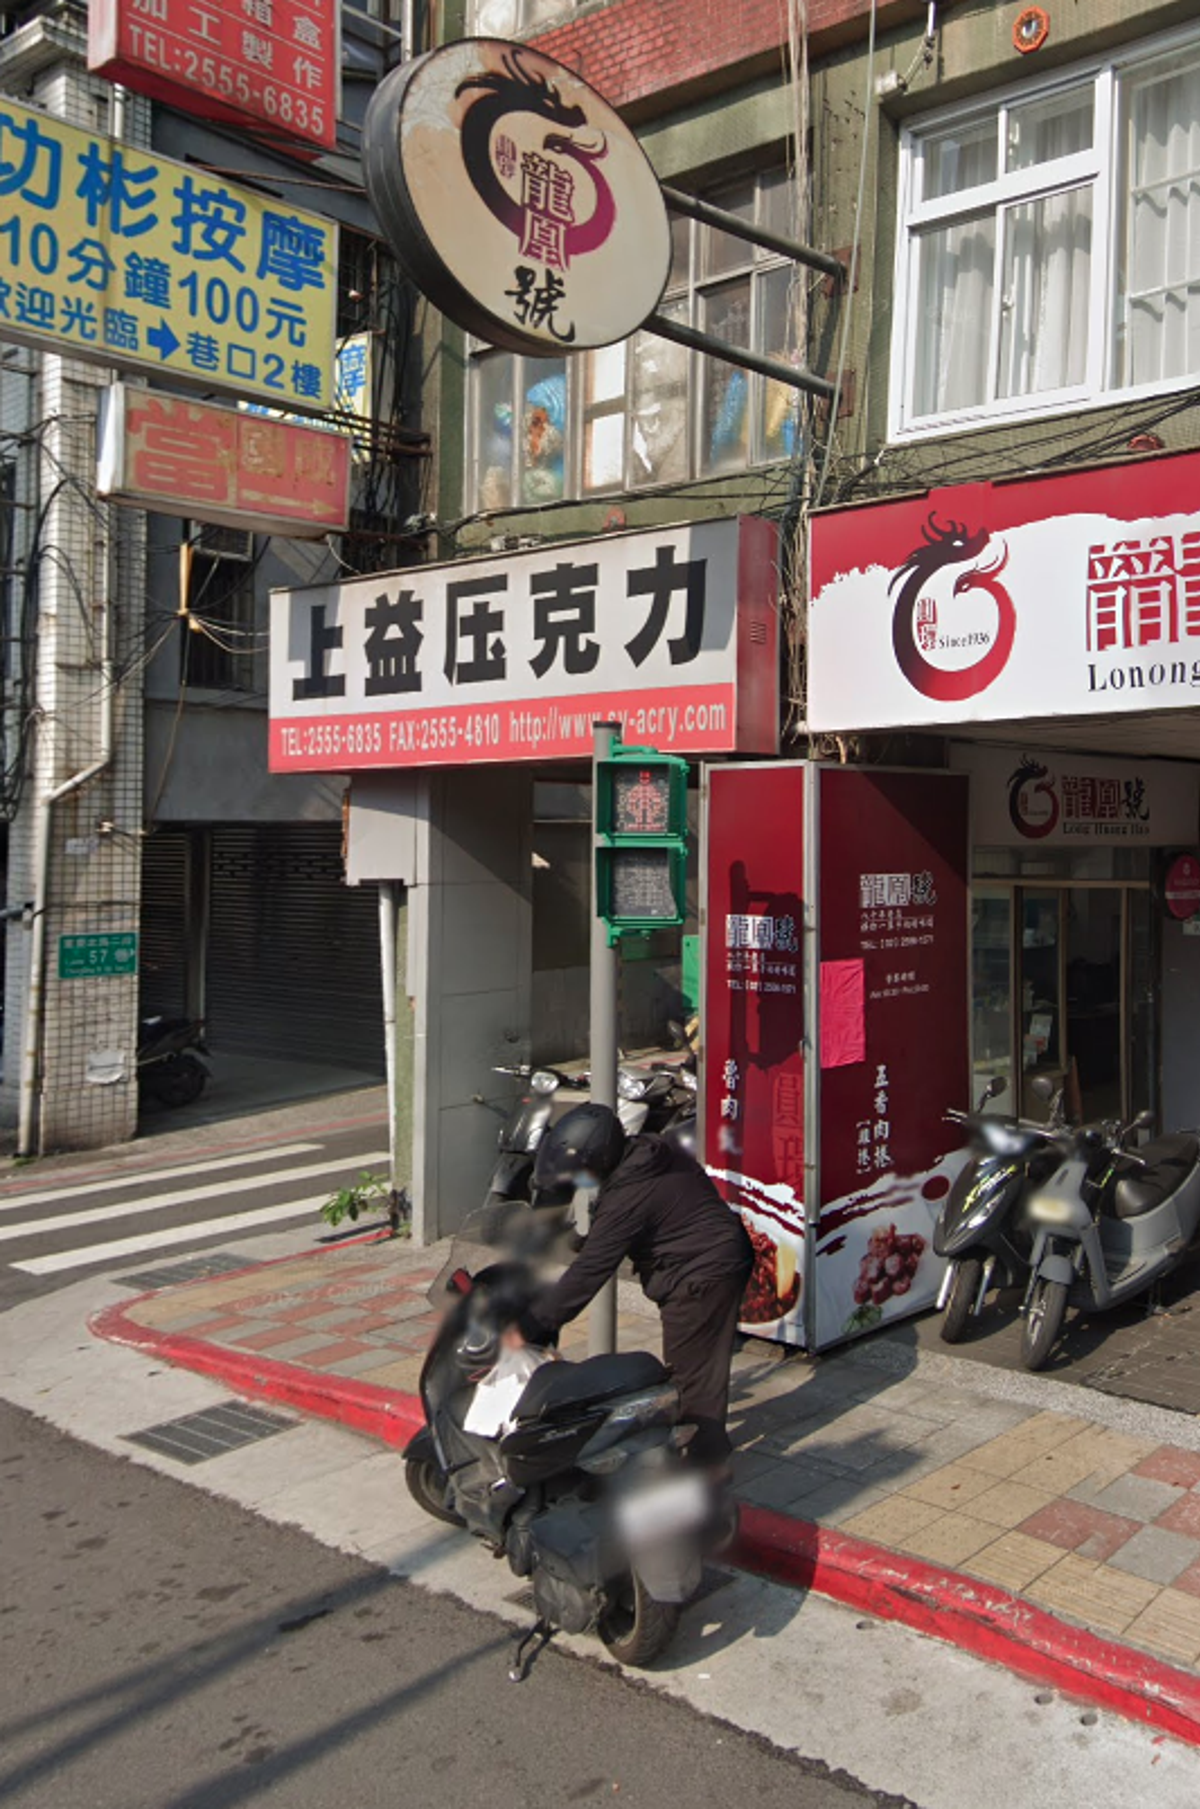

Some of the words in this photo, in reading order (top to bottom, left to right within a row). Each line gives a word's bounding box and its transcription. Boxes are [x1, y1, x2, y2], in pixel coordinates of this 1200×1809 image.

[127, 23, 325, 137] TEL:2555-6835
[185, 329, 323, 400] 巷口2樓
[291, 543, 709, 702] 上益压克力
[279, 719, 384, 757] TEL:2555-6835
[388, 711, 501, 752] FAX:2555-4810
[508, 701, 727, 750] http://wwwy-acry.com
[89, 948, 109, 964] 57
[719, 1059, 743, 1155] 魯肉
